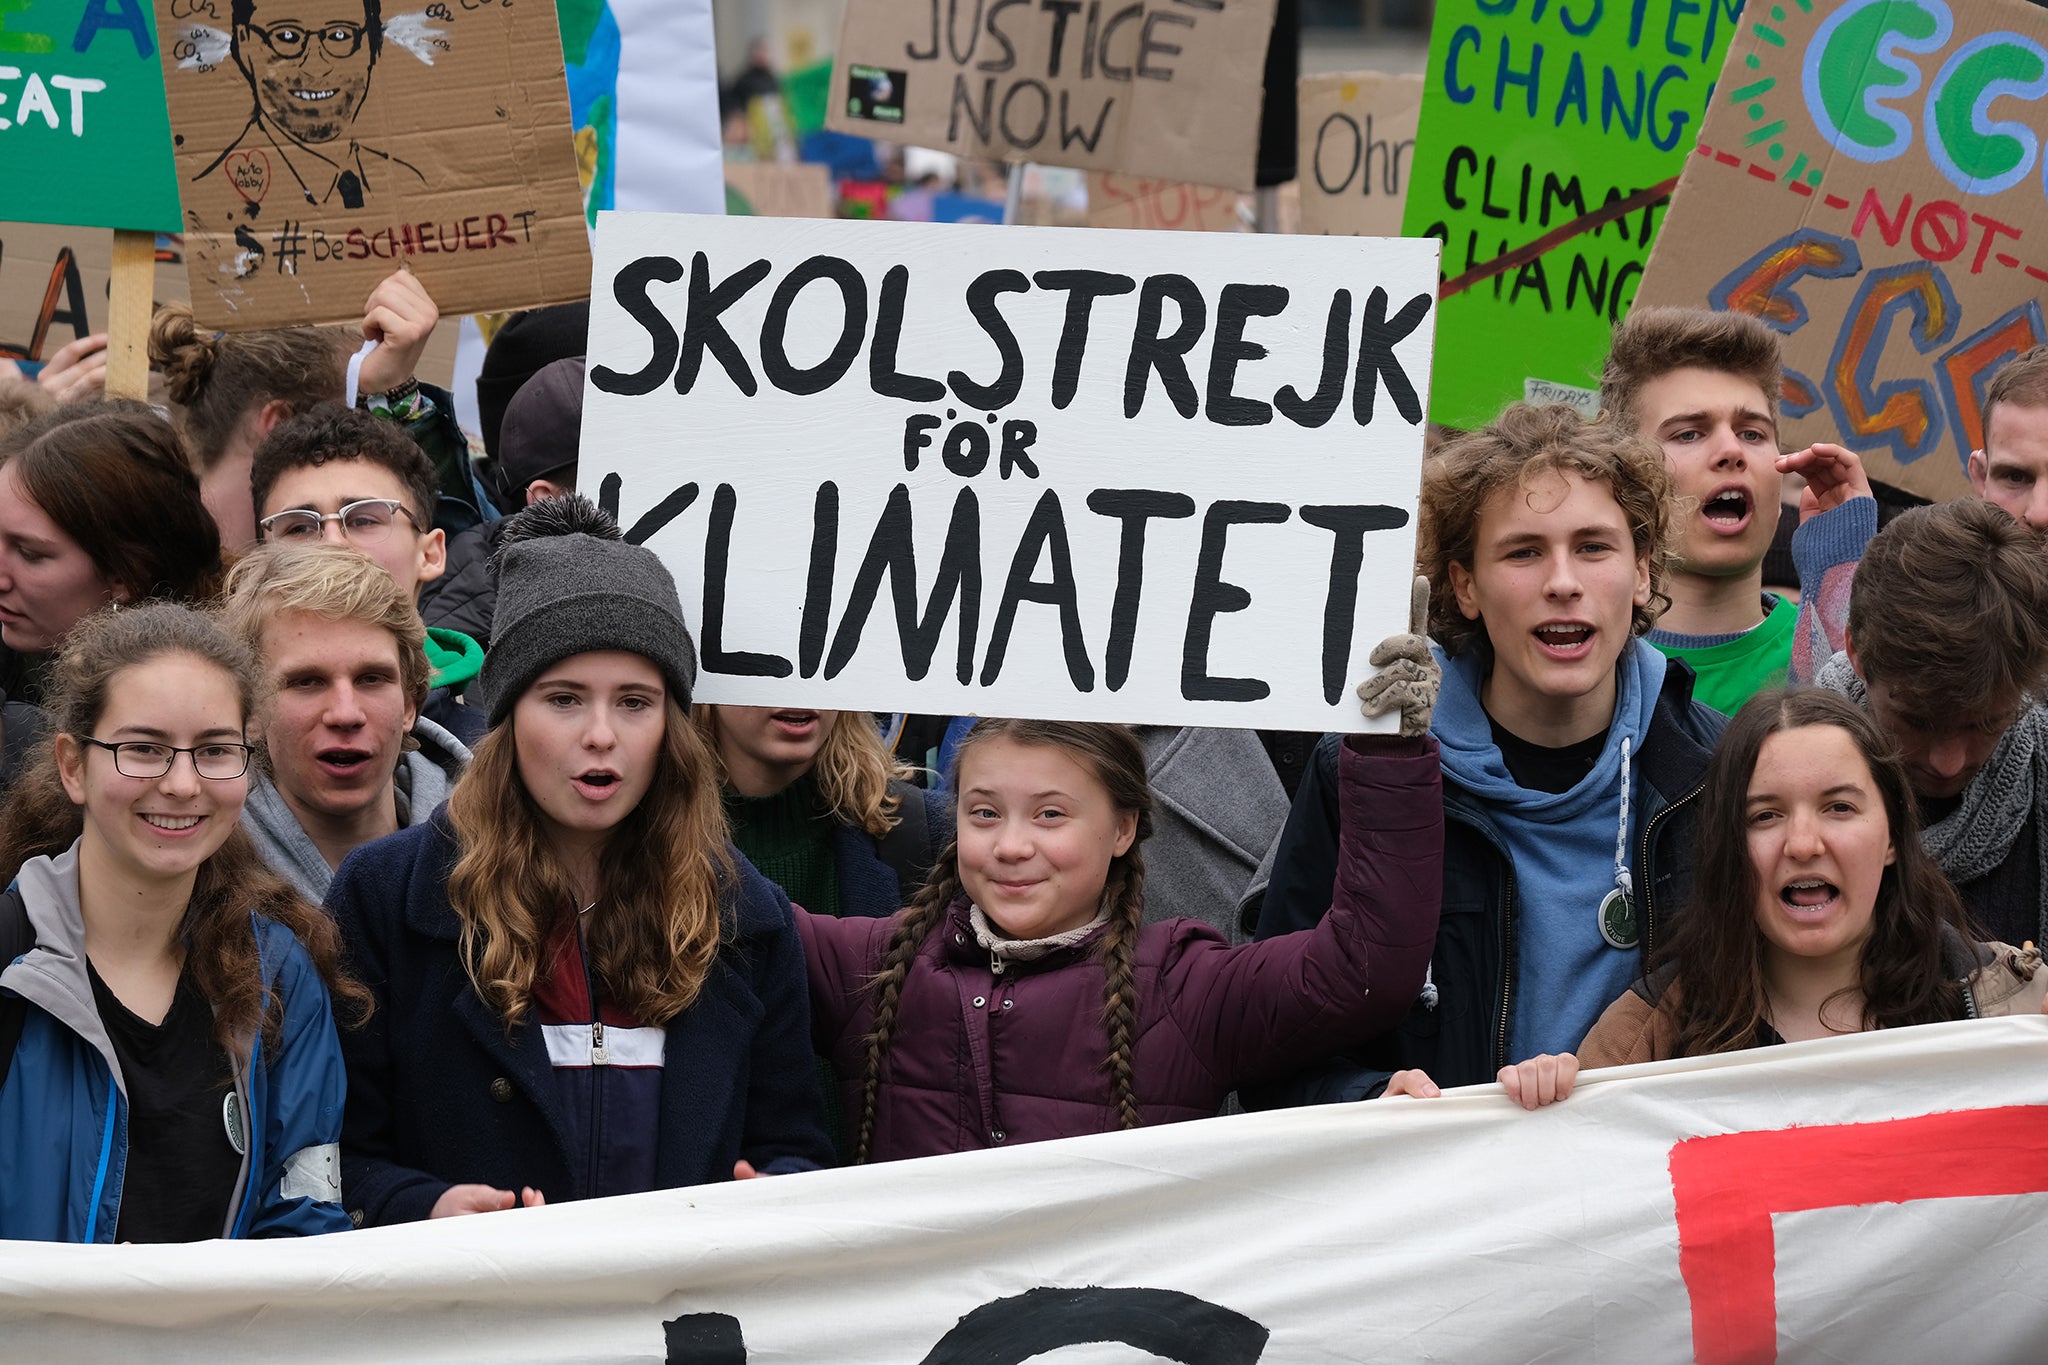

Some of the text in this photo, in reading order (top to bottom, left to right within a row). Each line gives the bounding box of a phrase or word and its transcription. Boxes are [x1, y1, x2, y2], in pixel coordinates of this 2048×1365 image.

[173, 39, 203, 62] CO2
[906, 0, 1195, 82] JUSTICE
[946, 73, 1116, 154] NOW
[1443, 24, 1716, 152] CHANG
[234, 177, 264, 193] lobby
[237, 162, 263, 177] Auto
[1851, 187, 2023, 275] NOT
[590, 250, 1433, 428] SKOLSTREJK
[1529, 380, 1591, 407] FRIDAYS
[904, 408, 1040, 480] FÖR
